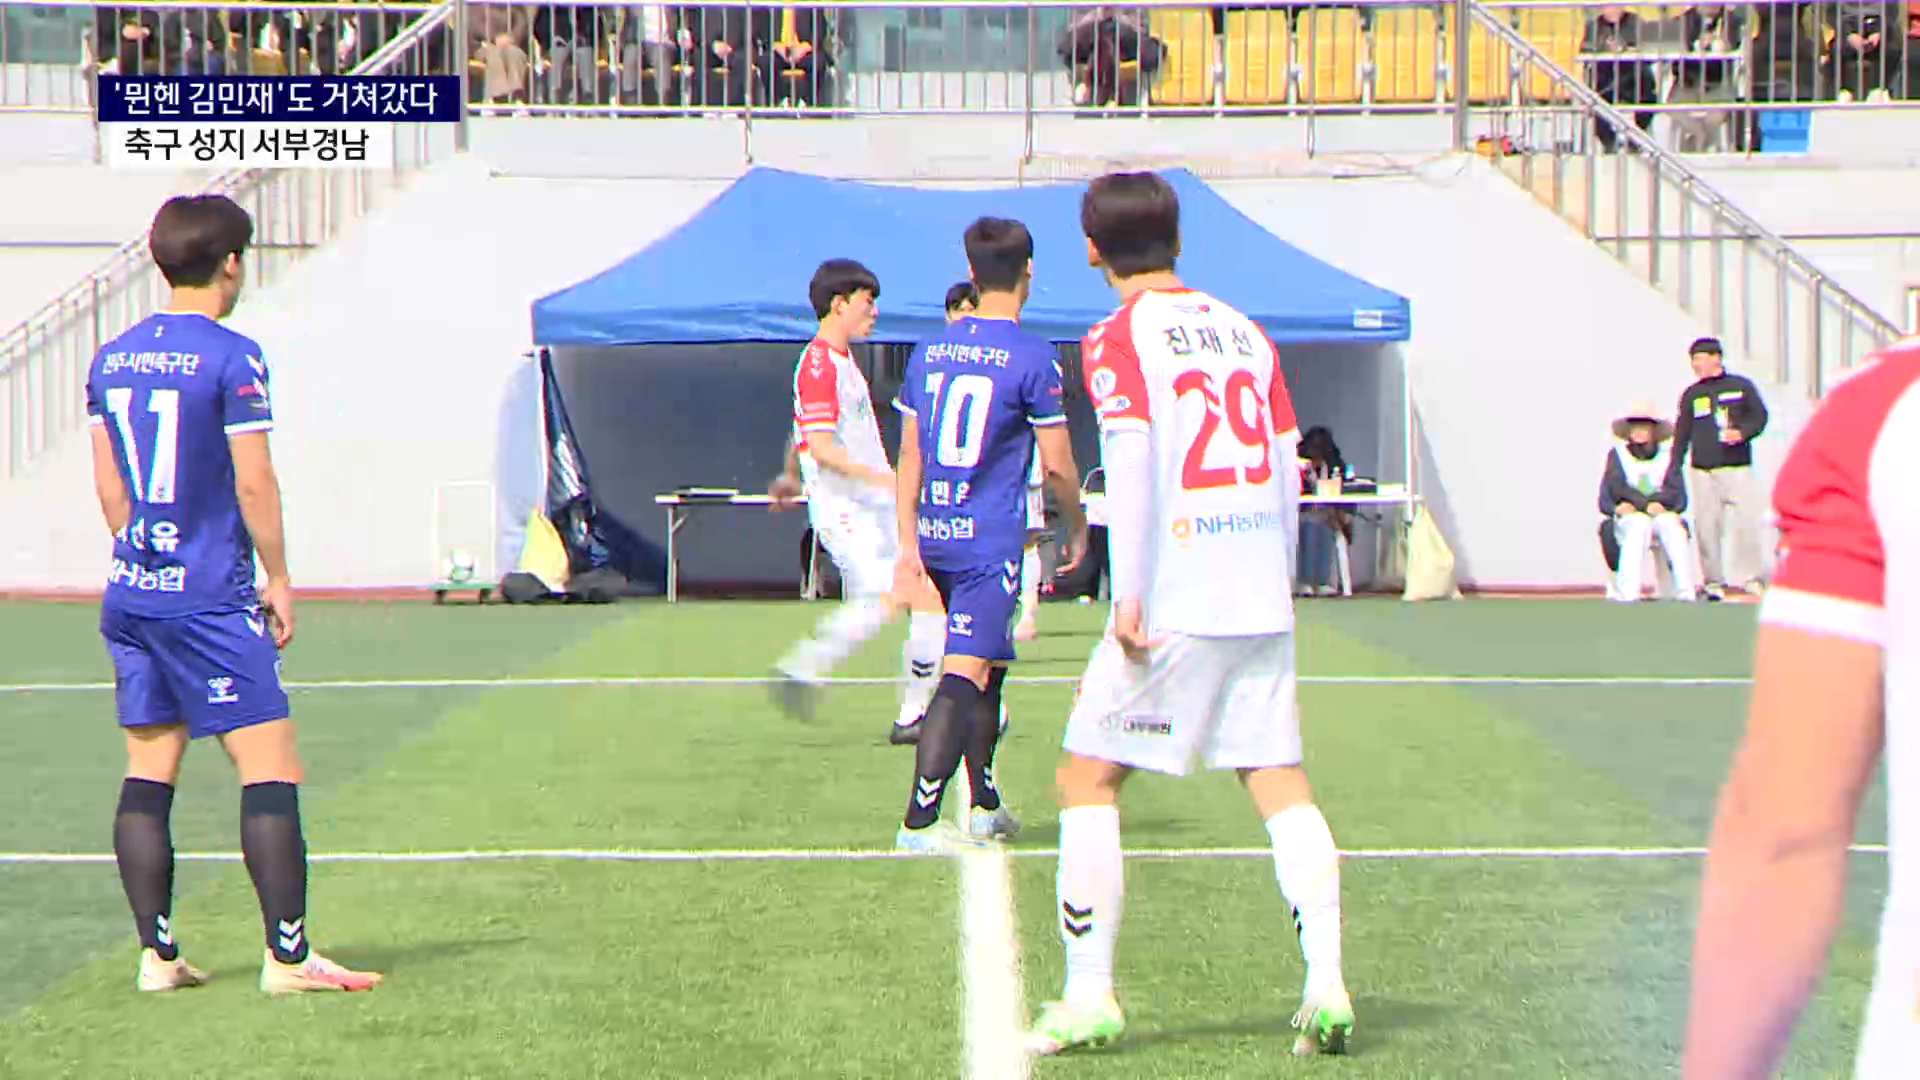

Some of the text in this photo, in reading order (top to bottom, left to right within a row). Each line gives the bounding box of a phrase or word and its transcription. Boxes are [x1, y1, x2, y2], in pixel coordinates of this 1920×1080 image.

[105, 387, 180, 504] 11
[924, 372, 994, 468] 10
[1172, 367, 1273, 490] 29
